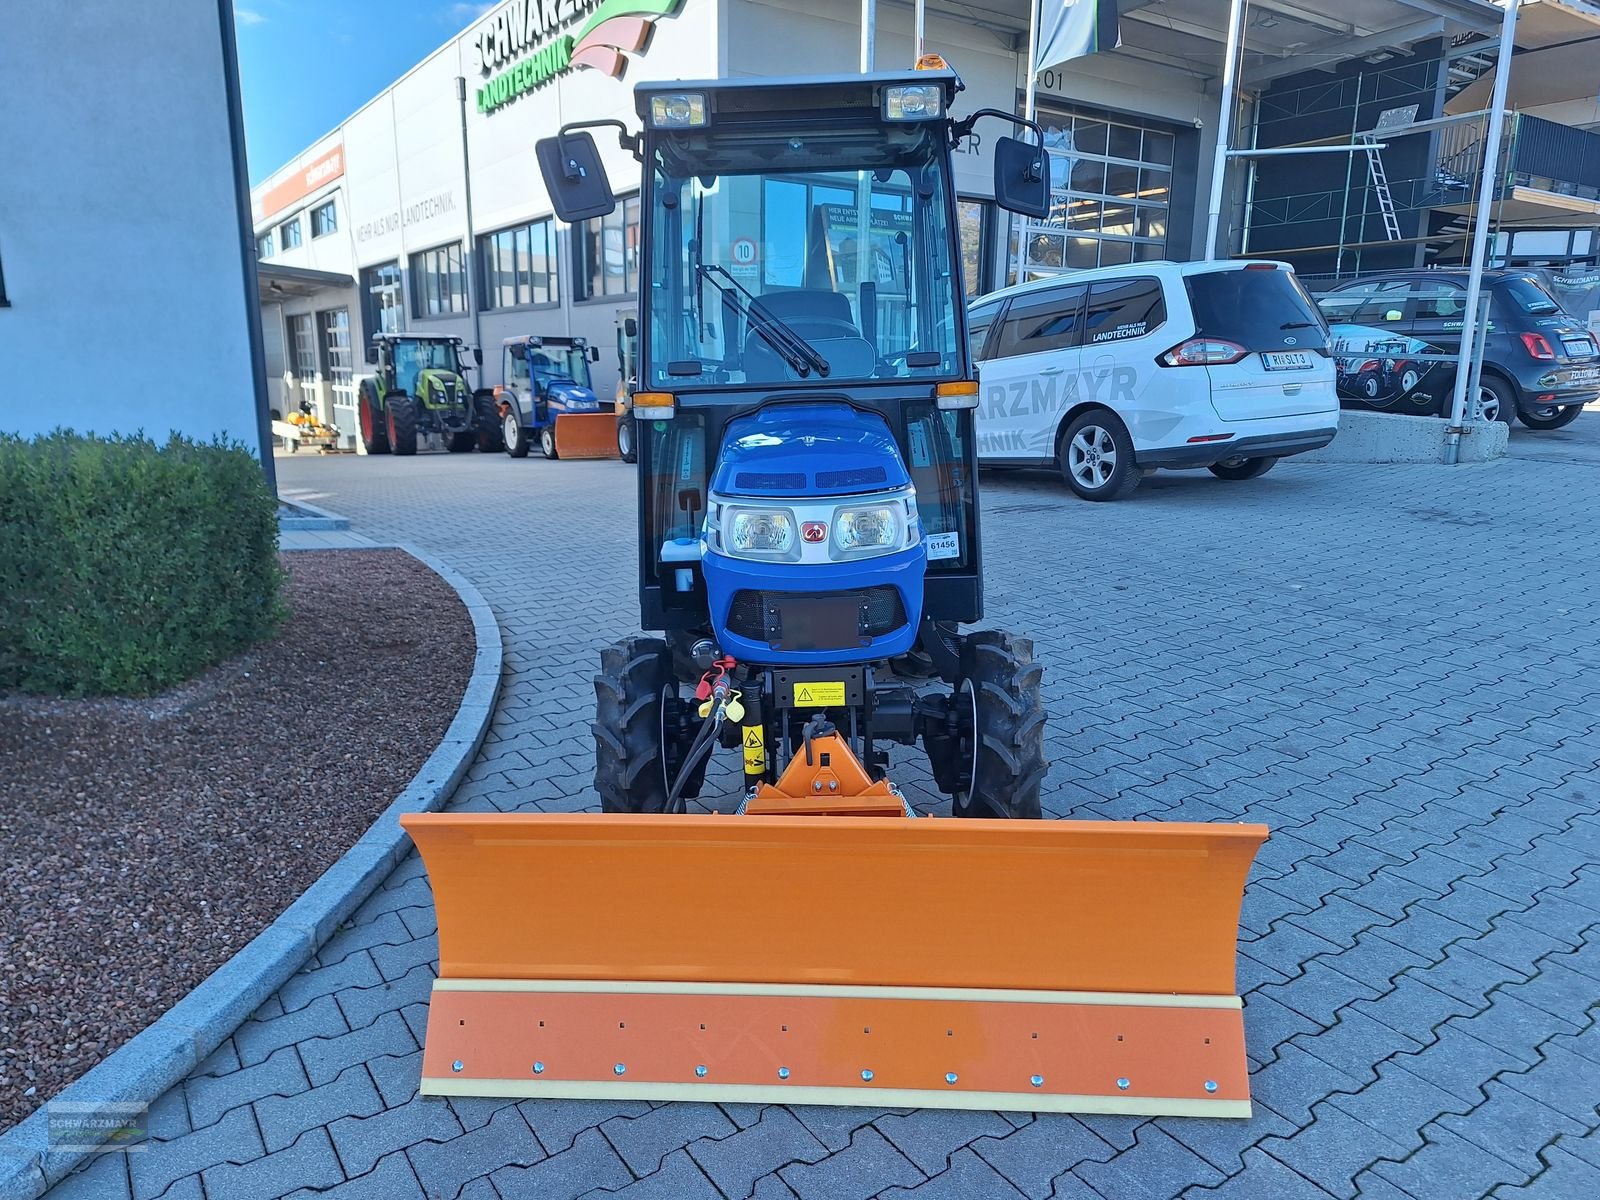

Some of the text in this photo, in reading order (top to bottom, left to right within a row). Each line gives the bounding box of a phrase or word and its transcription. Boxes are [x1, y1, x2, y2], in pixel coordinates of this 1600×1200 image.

[476, 34, 571, 114] LANDTECHNIK
[1044, 69, 1063, 91] 01
[373, 218, 385, 237] ALS
[385, 212, 400, 233] NUR
[738, 244, 750, 259] 10
[1093, 326, 1146, 342] LANDTECHNIK
[1286, 353, 1299, 365] SLT
[930, 540, 956, 550] 61456
